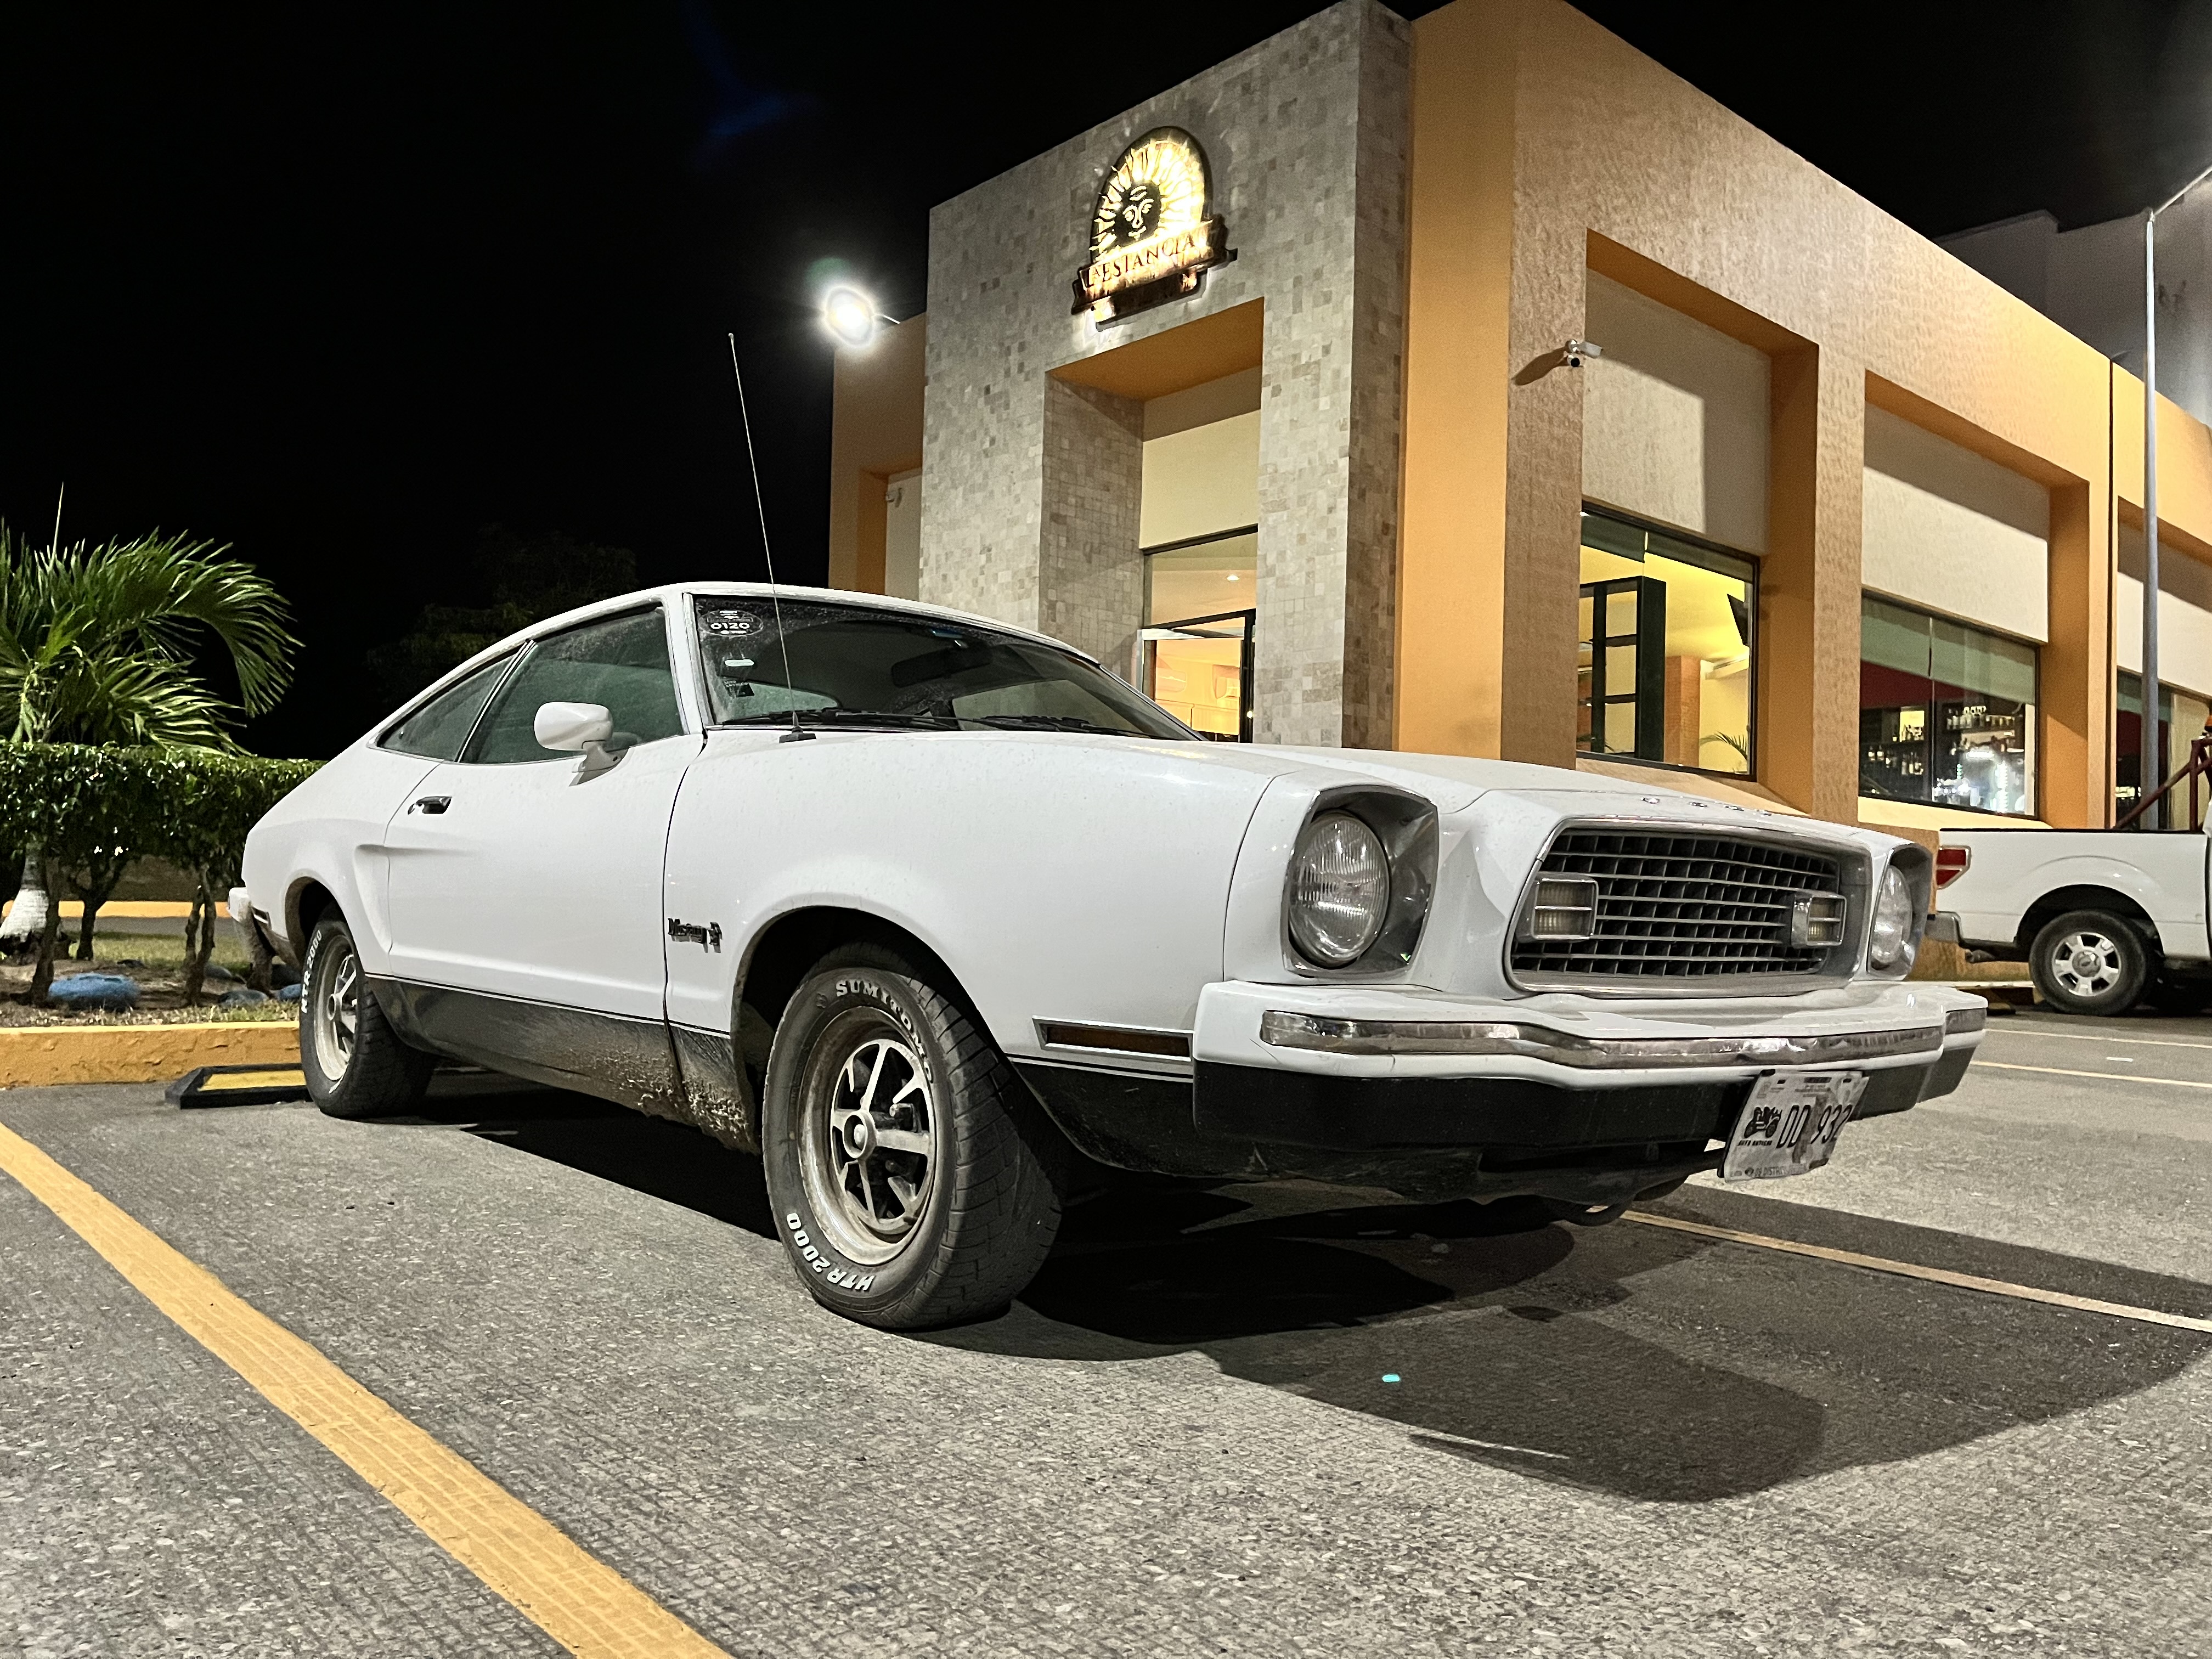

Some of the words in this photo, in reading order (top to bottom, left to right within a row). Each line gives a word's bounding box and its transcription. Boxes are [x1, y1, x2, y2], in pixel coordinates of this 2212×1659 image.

[307, 930, 322, 969] 2000
[836, 980, 932, 1081] SUMITOMO
[1810, 1104, 1853, 1144] 932
[786, 1212, 831, 1273] 2000
[827, 1268, 876, 1291] HTR
